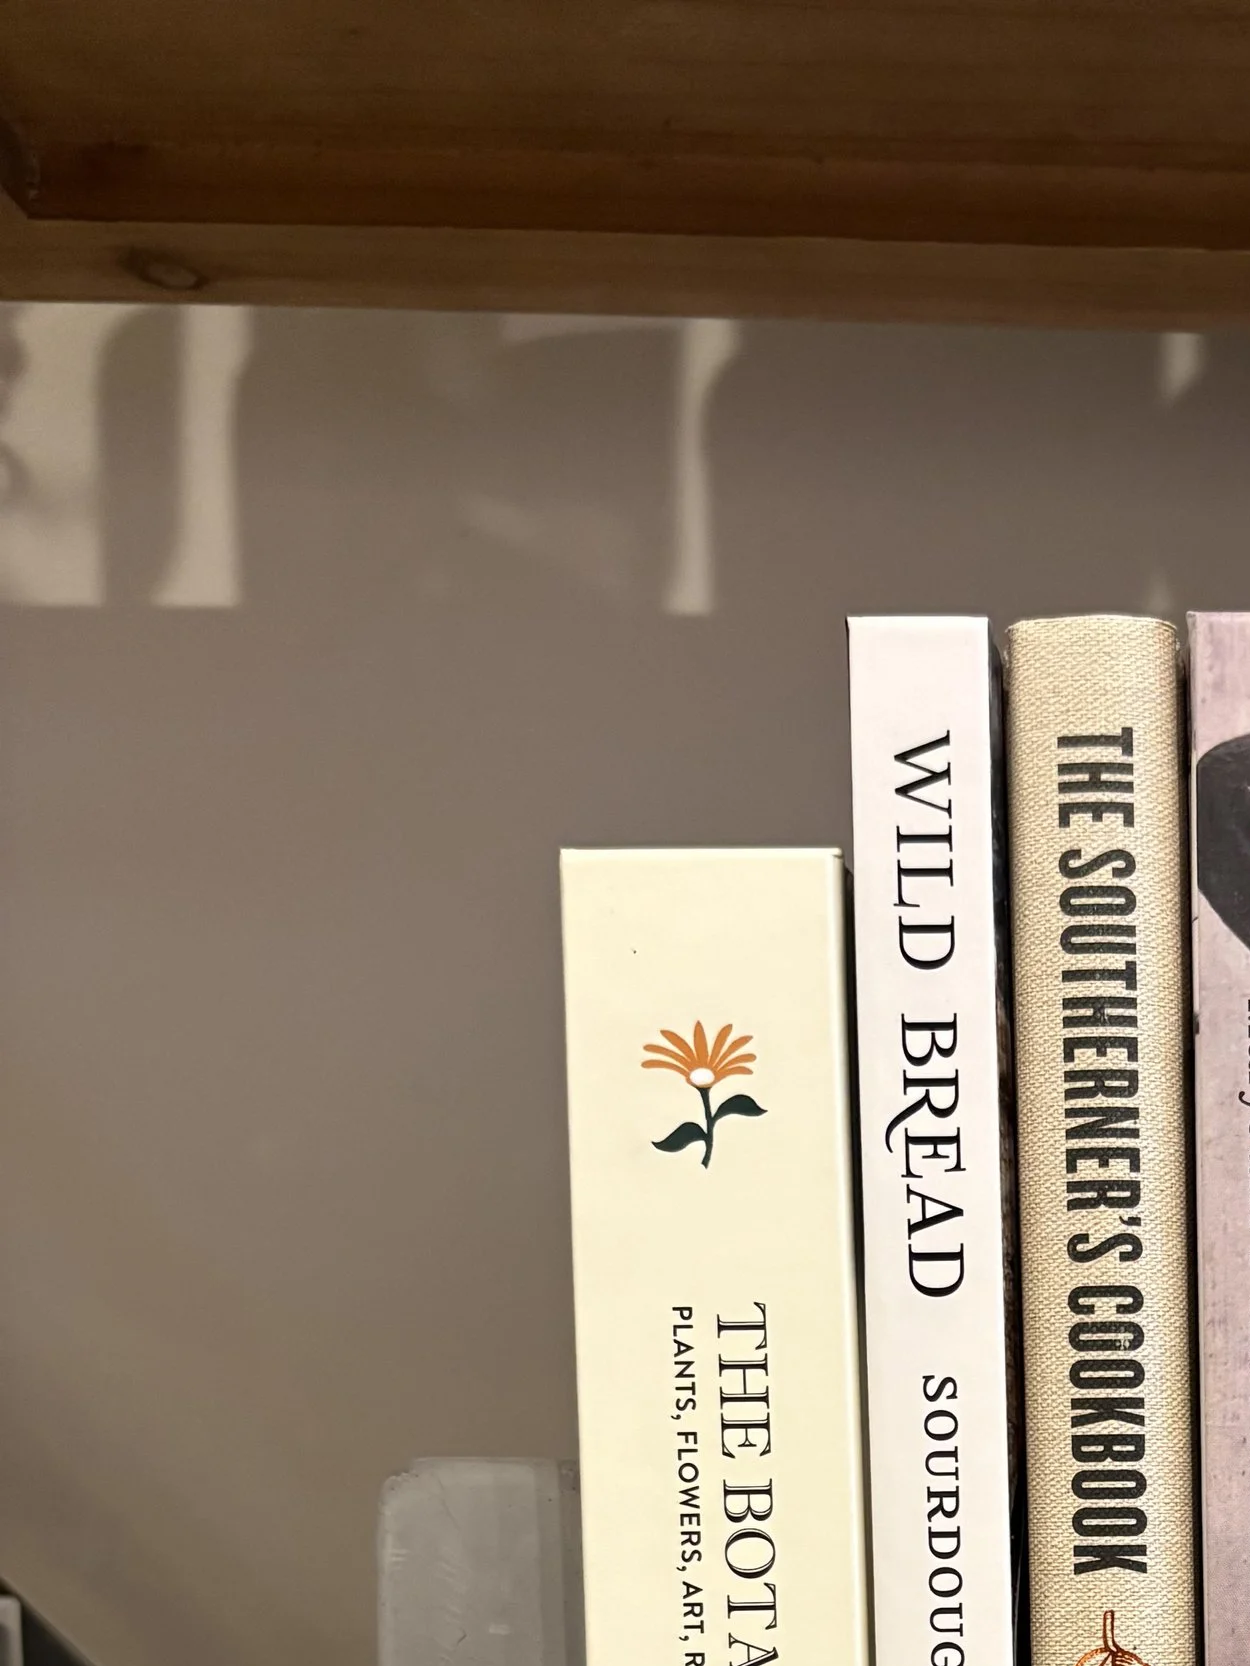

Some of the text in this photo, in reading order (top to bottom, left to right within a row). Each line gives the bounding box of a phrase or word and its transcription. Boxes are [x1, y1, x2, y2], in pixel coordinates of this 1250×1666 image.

[1057, 727, 1133, 829] THE
[885, 730, 967, 1298] WILD BREAD
[671, 1306, 697, 1421] PLANTS,
[716, 1302, 774, 1459] THE
[1067, 1285, 1148, 1576] COOKBOOK
[676, 1432, 703, 1572] FLOWERS,
[679, 1581, 704, 1642] ART,
